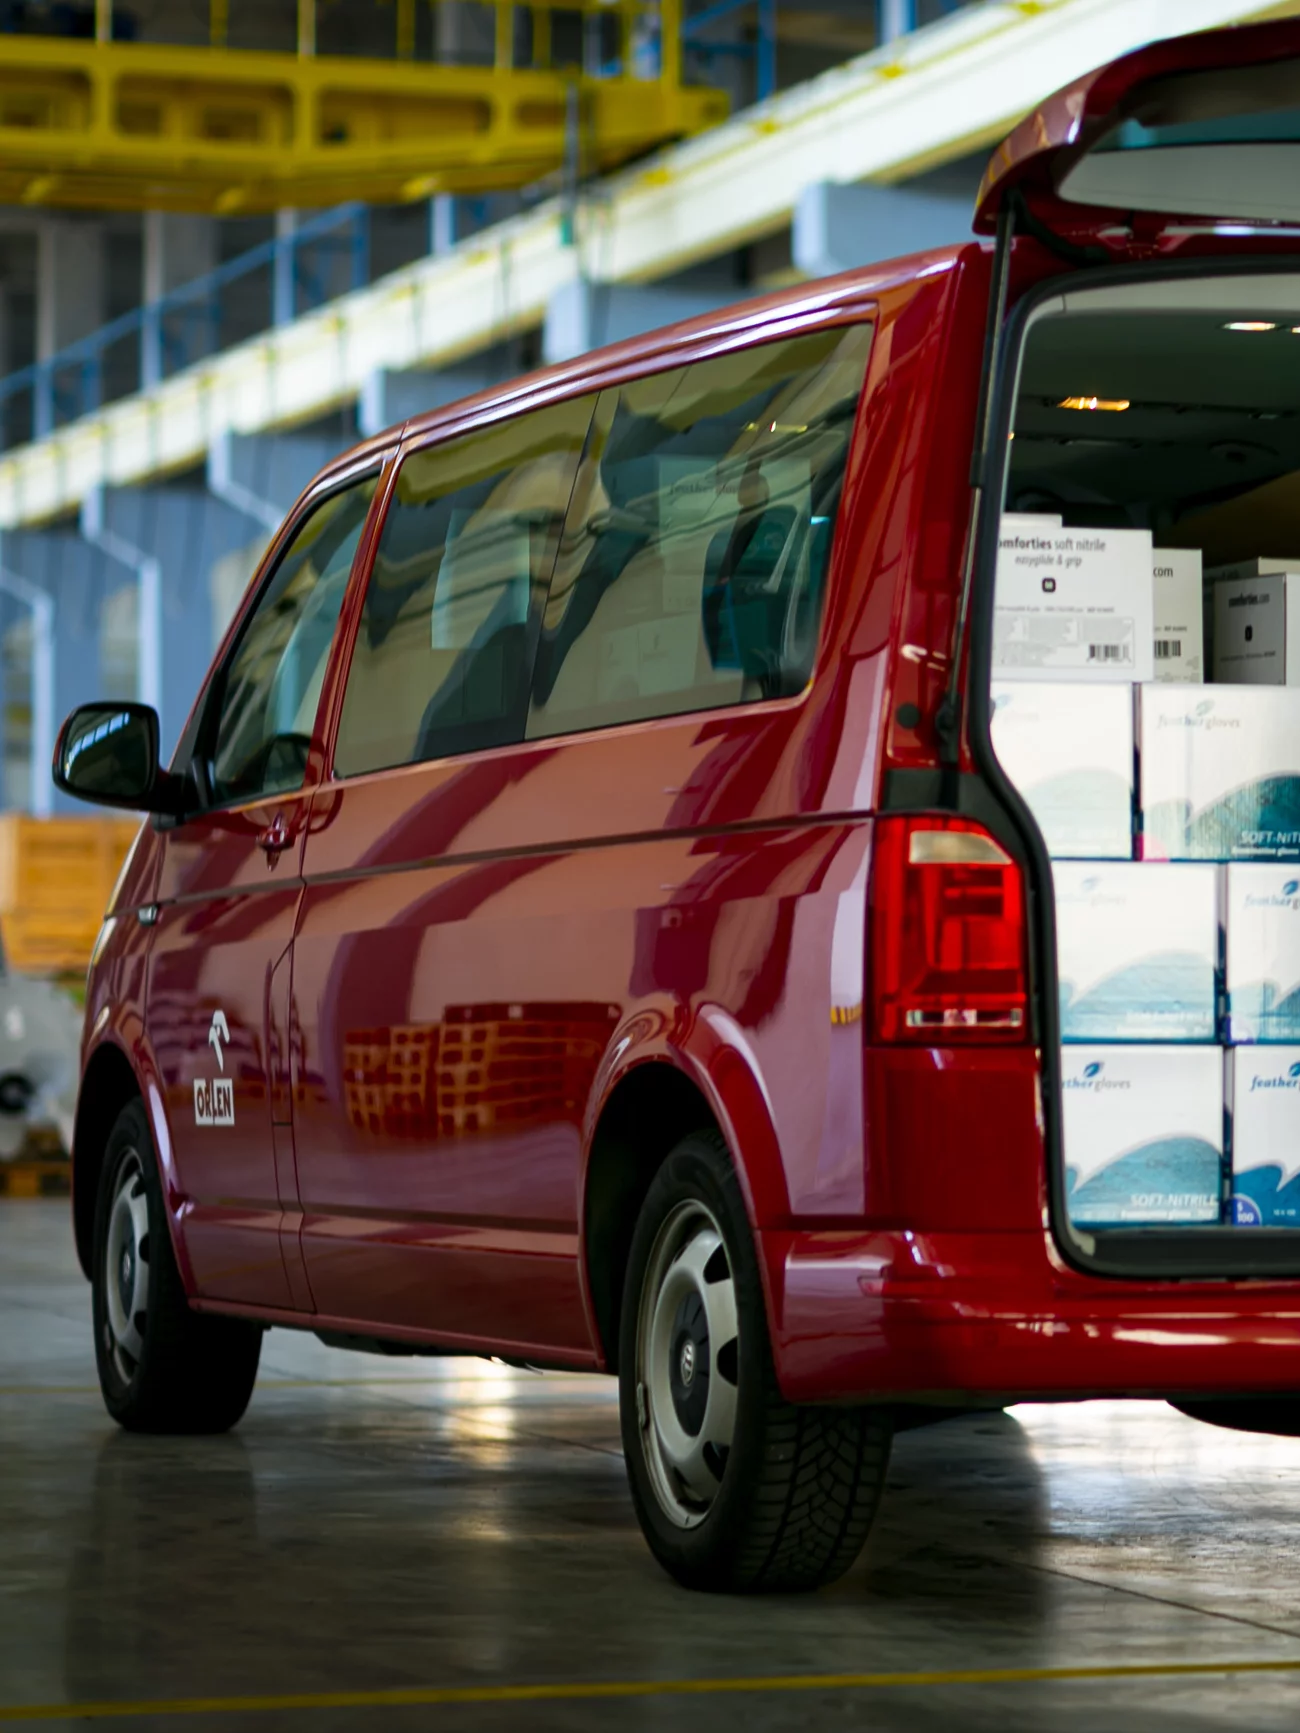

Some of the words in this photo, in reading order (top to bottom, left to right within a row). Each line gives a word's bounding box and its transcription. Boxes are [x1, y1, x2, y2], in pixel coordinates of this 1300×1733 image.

[998, 536, 1052, 550] omforties
[1054, 538, 1073, 551] soft
[1076, 538, 1106, 551] nitrile
[1066, 555, 1082, 568] grip
[196, 1083, 233, 1120] ORLEN
